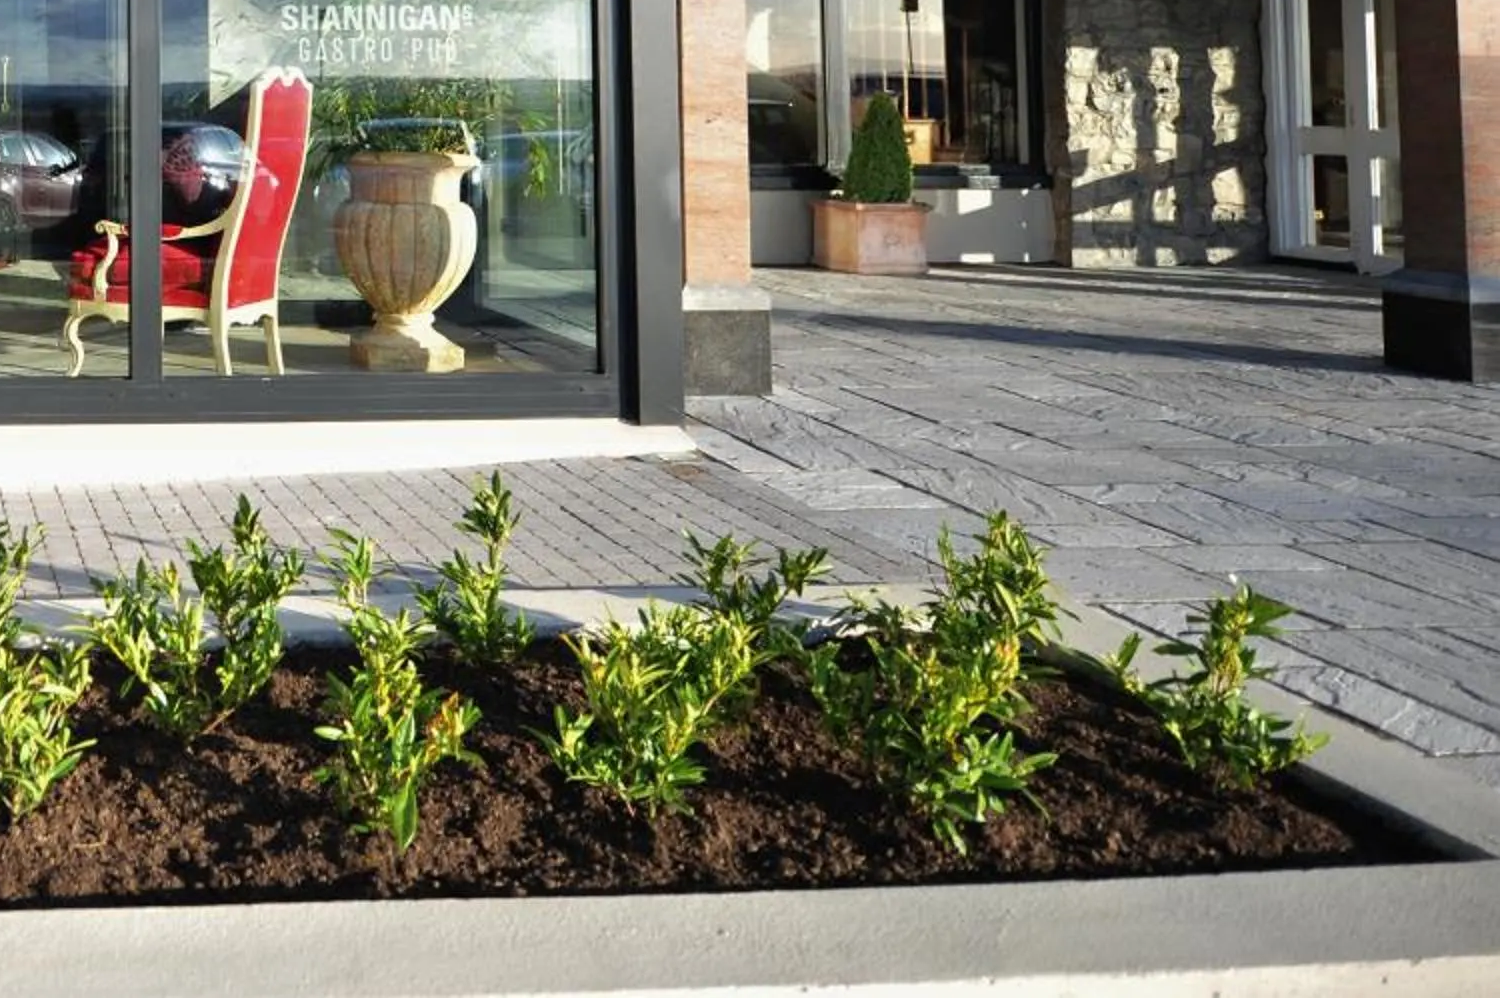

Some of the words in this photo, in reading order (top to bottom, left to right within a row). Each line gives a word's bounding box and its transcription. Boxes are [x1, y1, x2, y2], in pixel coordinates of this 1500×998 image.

[280, 4, 474, 31] SHANNIGANS
[299, 36, 393, 63] GASTRO
[410, 37, 458, 63] PUB
